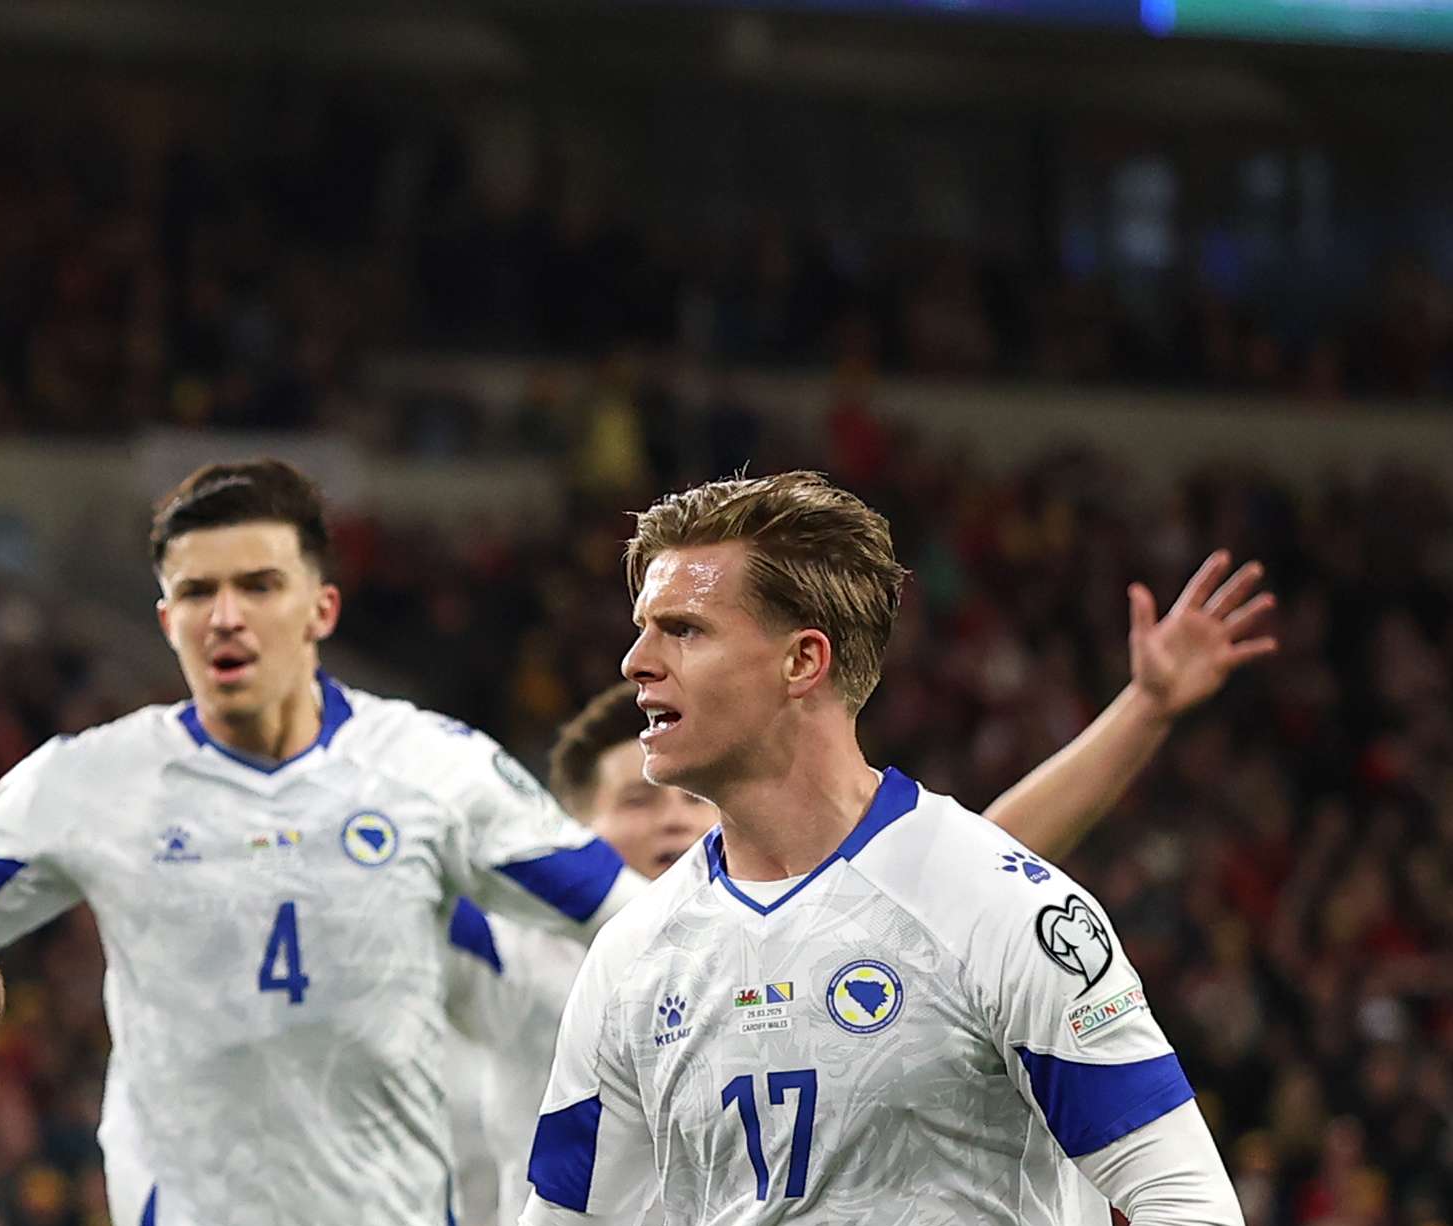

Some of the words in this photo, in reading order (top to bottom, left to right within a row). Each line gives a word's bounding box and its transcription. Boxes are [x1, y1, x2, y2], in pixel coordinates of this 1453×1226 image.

[258, 901, 310, 1004] 4
[1068, 1004, 1092, 1021] UEFA
[721, 1068, 818, 1201] 17
